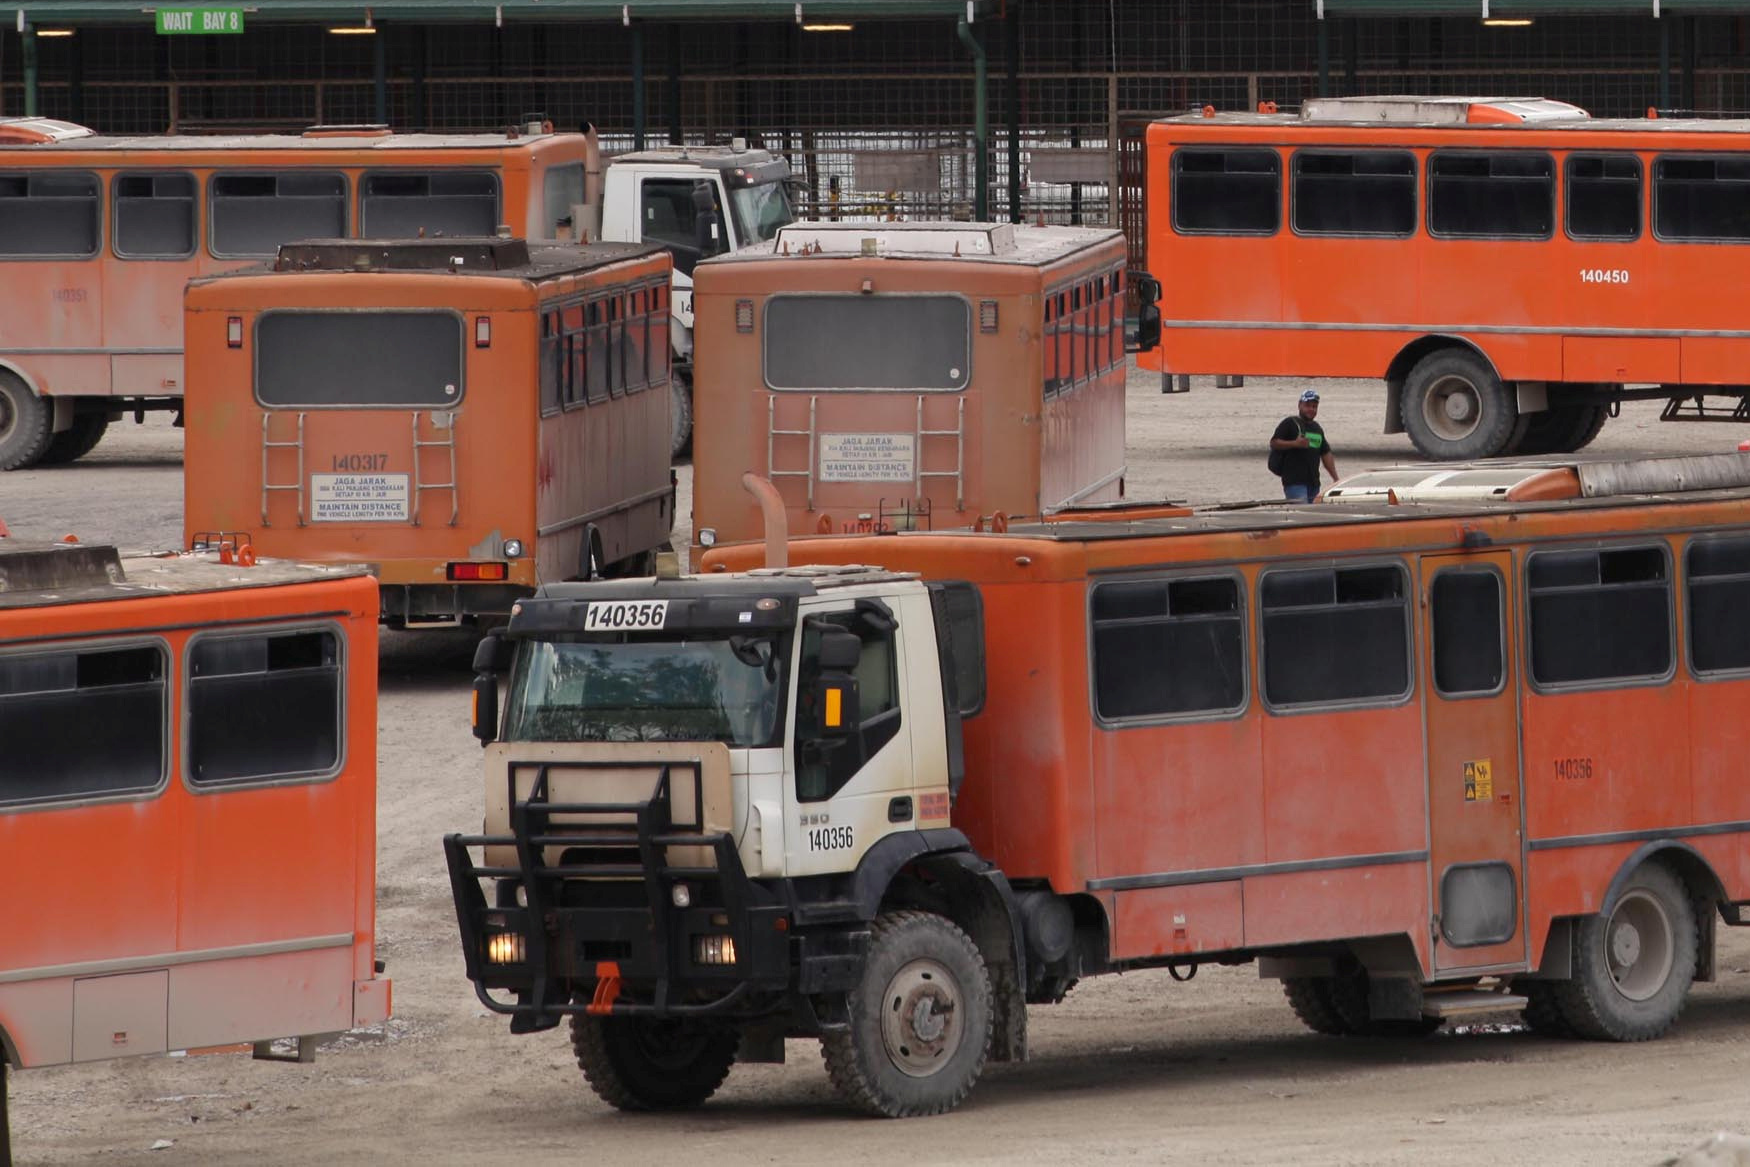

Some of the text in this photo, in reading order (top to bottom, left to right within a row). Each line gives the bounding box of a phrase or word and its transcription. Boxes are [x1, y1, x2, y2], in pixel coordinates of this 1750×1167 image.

[163, 12, 238, 31] WAIT BAY 8
[1580, 269, 1629, 284] 140450
[332, 454, 388, 472] 140317
[319, 503, 401, 511] MAINTAIN DISTANCE
[589, 604, 664, 627] 140356
[1554, 758, 1592, 780] 140356
[808, 826, 853, 851] 140356
